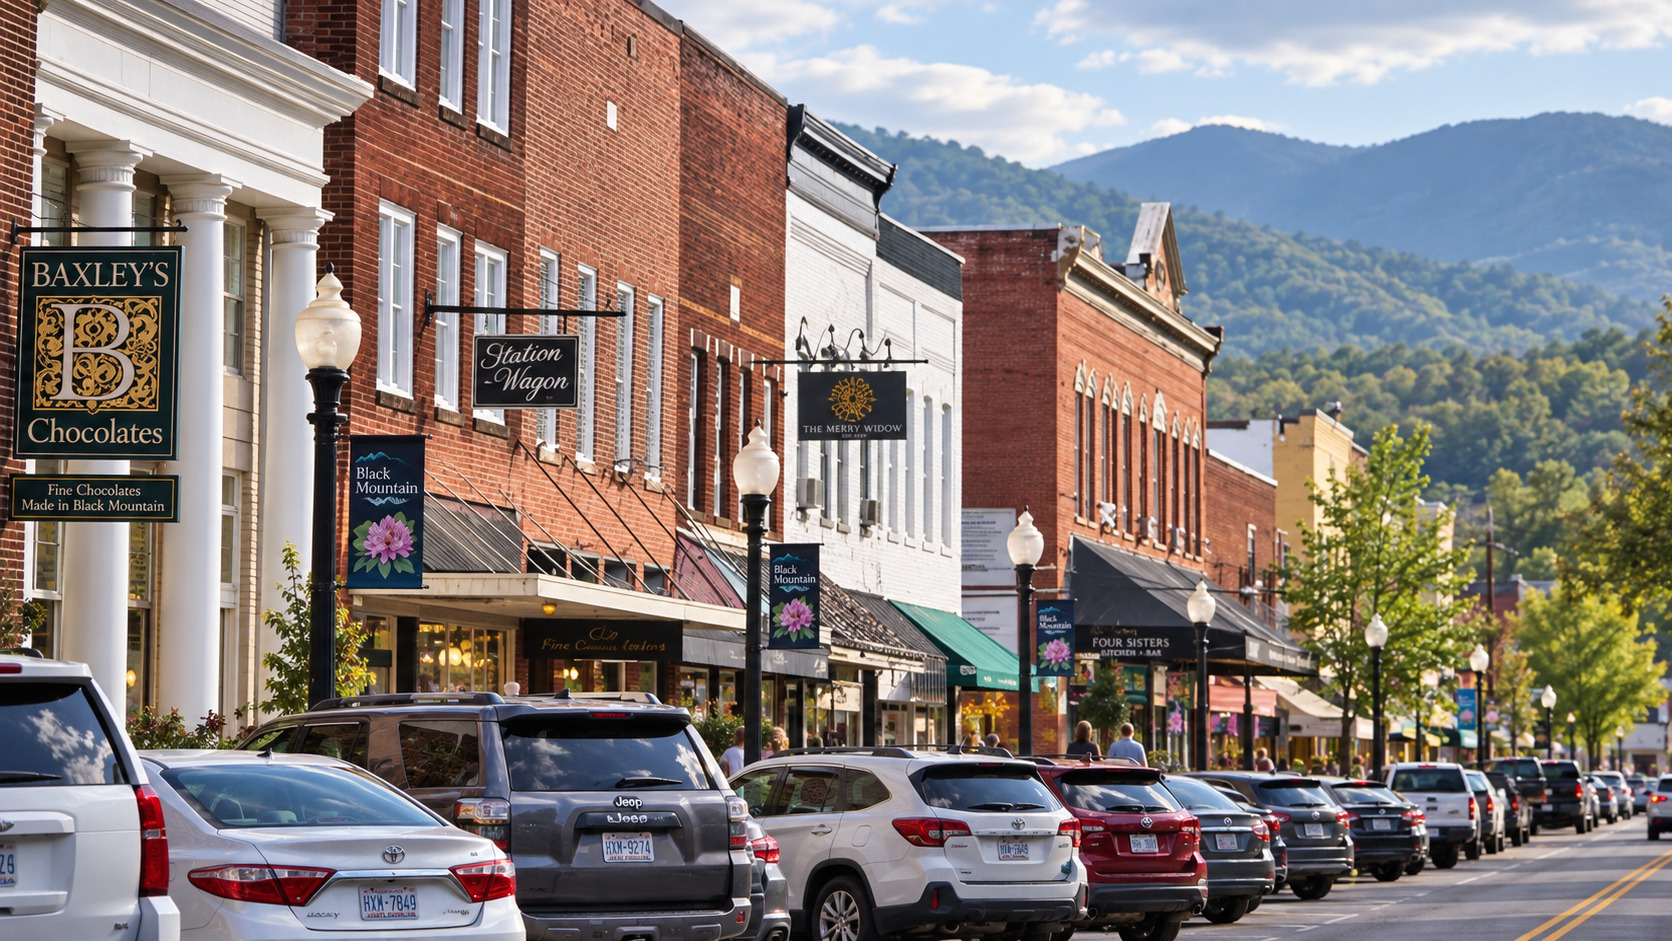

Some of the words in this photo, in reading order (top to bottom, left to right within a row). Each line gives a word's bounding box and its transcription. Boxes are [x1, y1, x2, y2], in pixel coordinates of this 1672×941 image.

[31, 262, 169, 287] BAXLEY'S
[49, 303, 135, 401] B
[480, 342, 563, 369] Station
[27, 417, 163, 444] Chocolates
[803, 425, 823, 433] THE
[826, 424, 861, 433] MERRY
[863, 424, 902, 433] WIDOW
[356, 466, 391, 480] Black
[47, 483, 73, 496] Fine
[76, 483, 141, 496] Chocolates
[355, 481, 419, 494] Mountain
[22, 499, 55, 511] Made
[58, 499, 69, 511] in
[73, 499, 104, 511] Black
[108, 500, 165, 512] Mountain
[774, 564, 797, 574] Black
[774, 573, 816, 584] Mountain
[1092, 637, 1123, 648] FOUR
[1126, 637, 1170, 648] SISTERS
